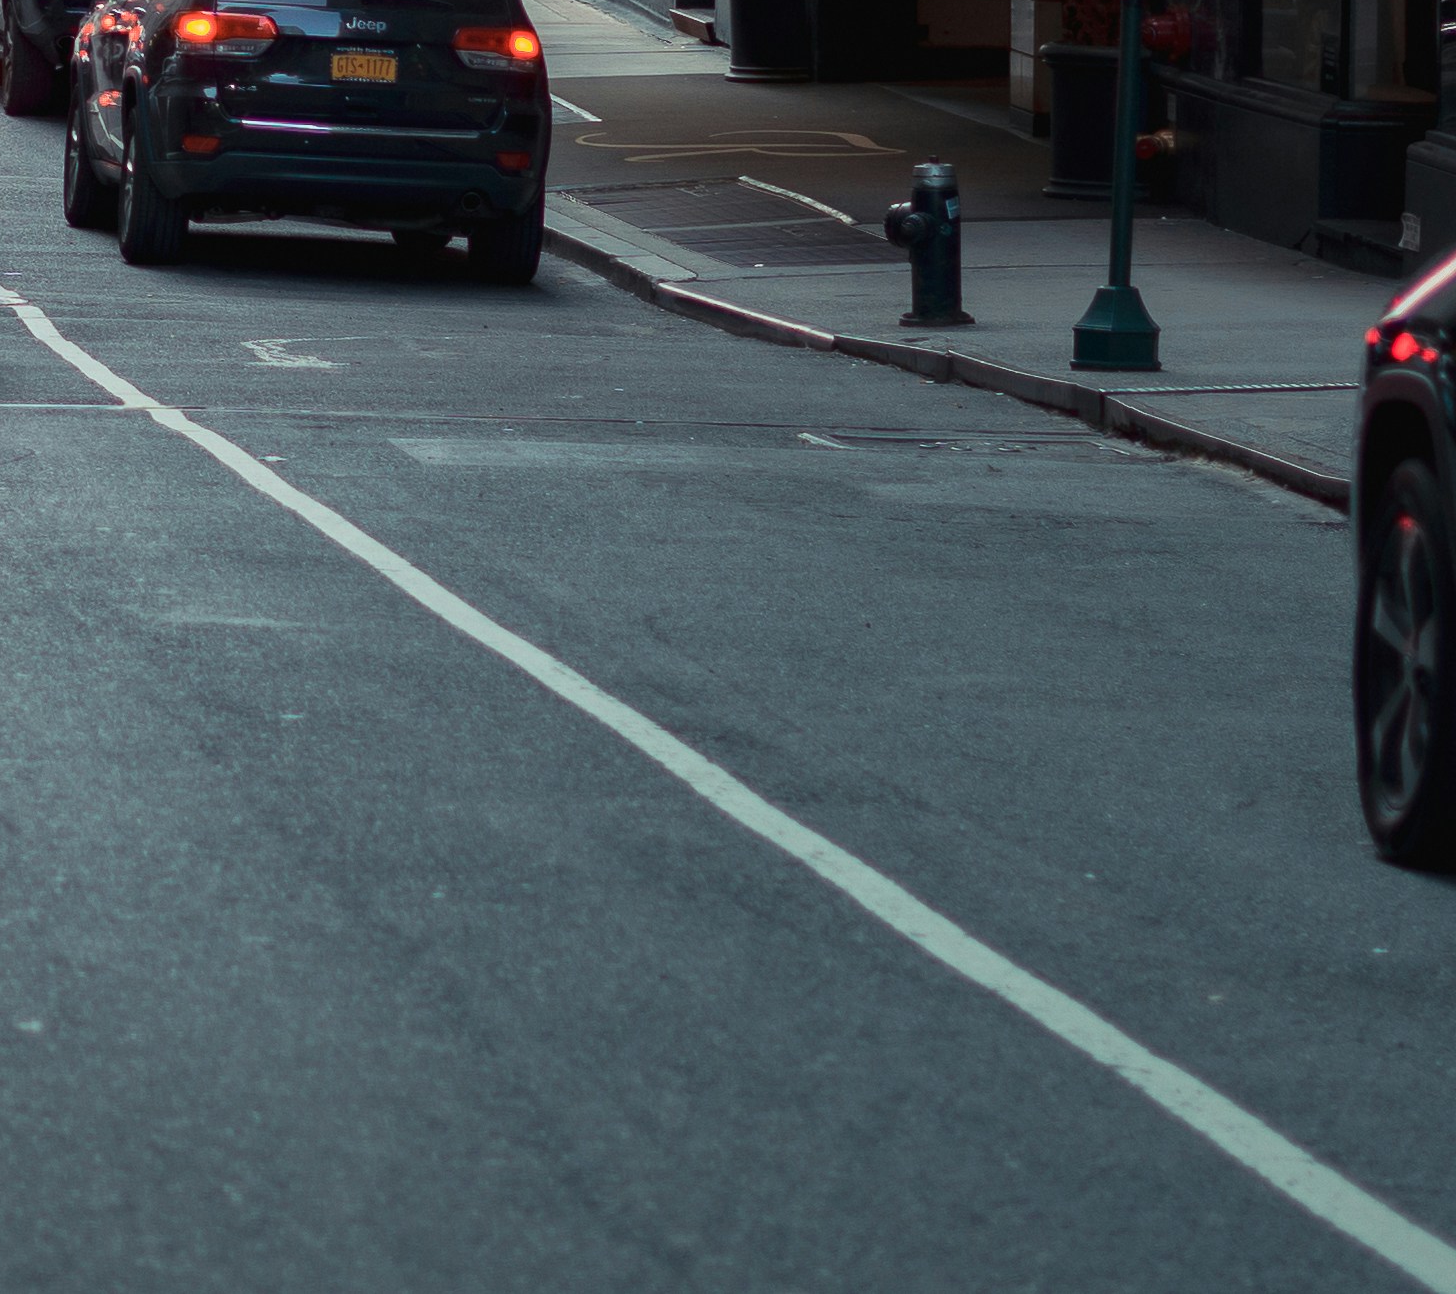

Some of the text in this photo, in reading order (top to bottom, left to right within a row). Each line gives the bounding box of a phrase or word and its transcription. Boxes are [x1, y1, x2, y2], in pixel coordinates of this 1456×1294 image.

[345, 16, 388, 33] Jeep
[337, 56, 393, 75] GTS 1177
